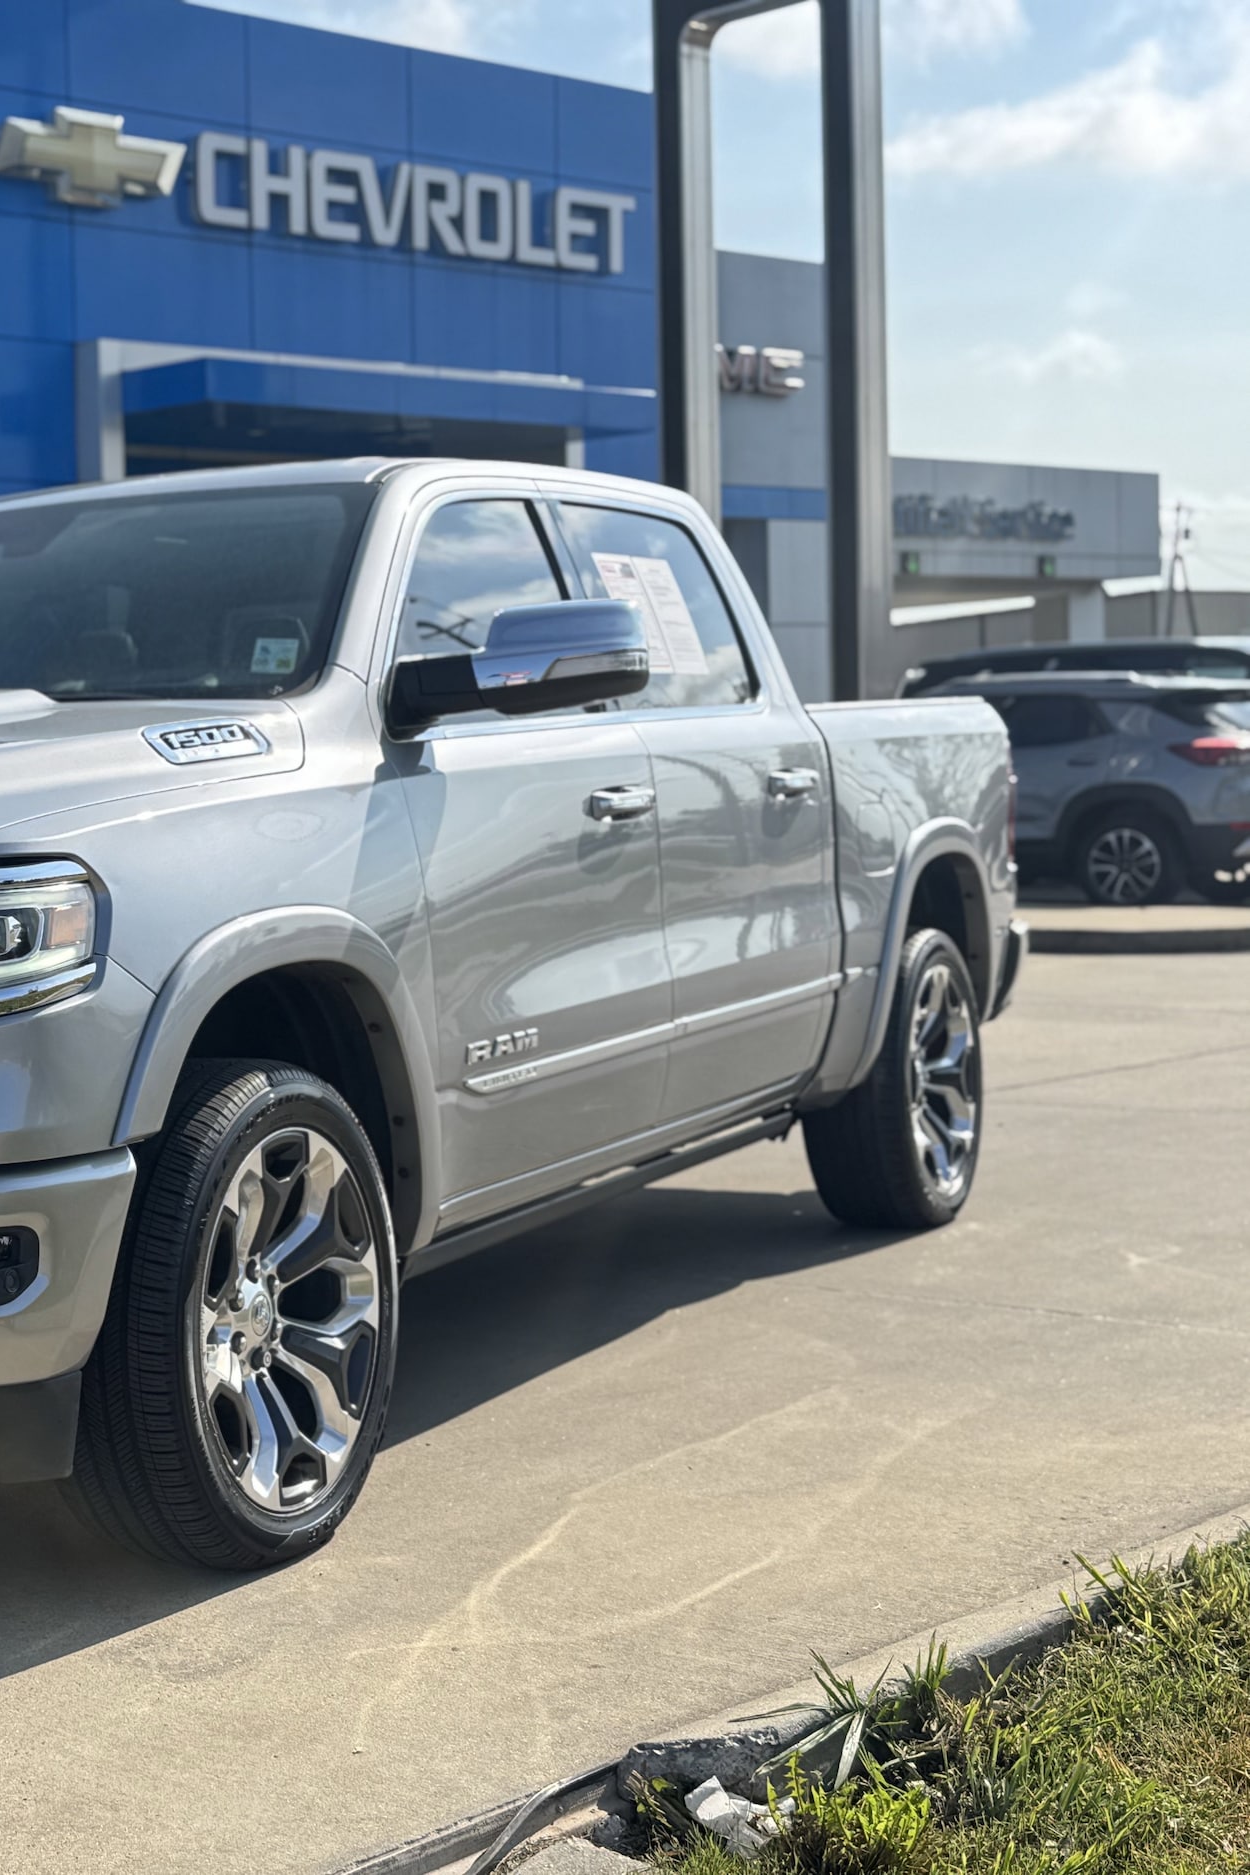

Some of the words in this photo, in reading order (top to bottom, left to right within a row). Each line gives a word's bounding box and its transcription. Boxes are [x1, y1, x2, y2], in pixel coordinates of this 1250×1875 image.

[196, 130, 638, 275] CHEVROLET
[165, 724, 246, 750] 1500
[464, 1027, 539, 1066] RAM
